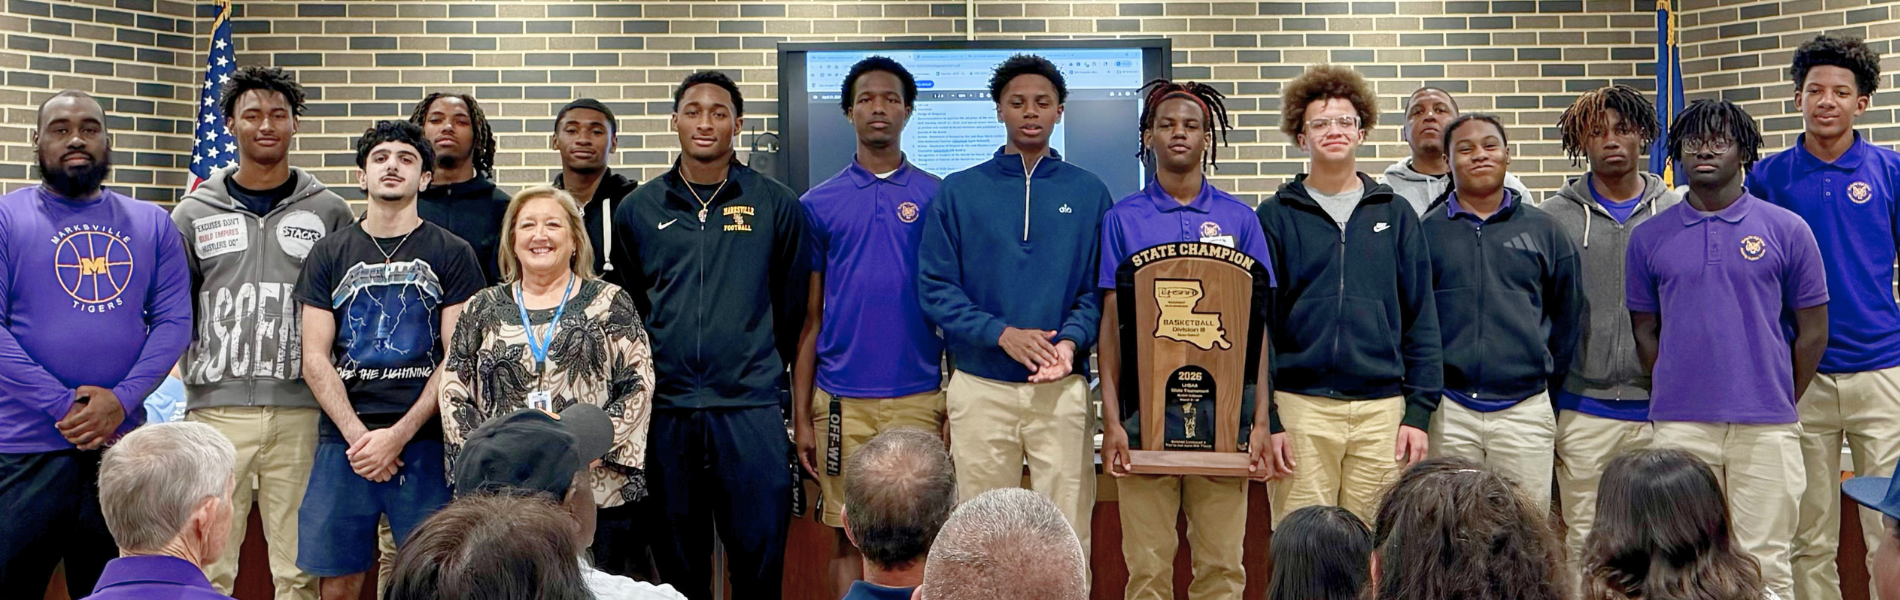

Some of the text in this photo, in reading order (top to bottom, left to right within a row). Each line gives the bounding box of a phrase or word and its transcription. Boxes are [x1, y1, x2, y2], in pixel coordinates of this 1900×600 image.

[50, 224, 131, 245] MARKSVILLE
[215, 228, 239, 239] EMPIRES
[283, 226, 321, 242] STACKS
[202, 241, 227, 252] HUSTLERS
[1131, 243, 1255, 271] STATE CHAMPION
[81, 257, 107, 276] M
[72, 297, 123, 313] TIGERS
[1163, 319, 1215, 327] BASKETBALL
[184, 282, 302, 385] ASCEN
[358, 368, 379, 380] THE
[380, 367, 432, 380] LIGHTNING
[1178, 371, 1202, 381] 2026
